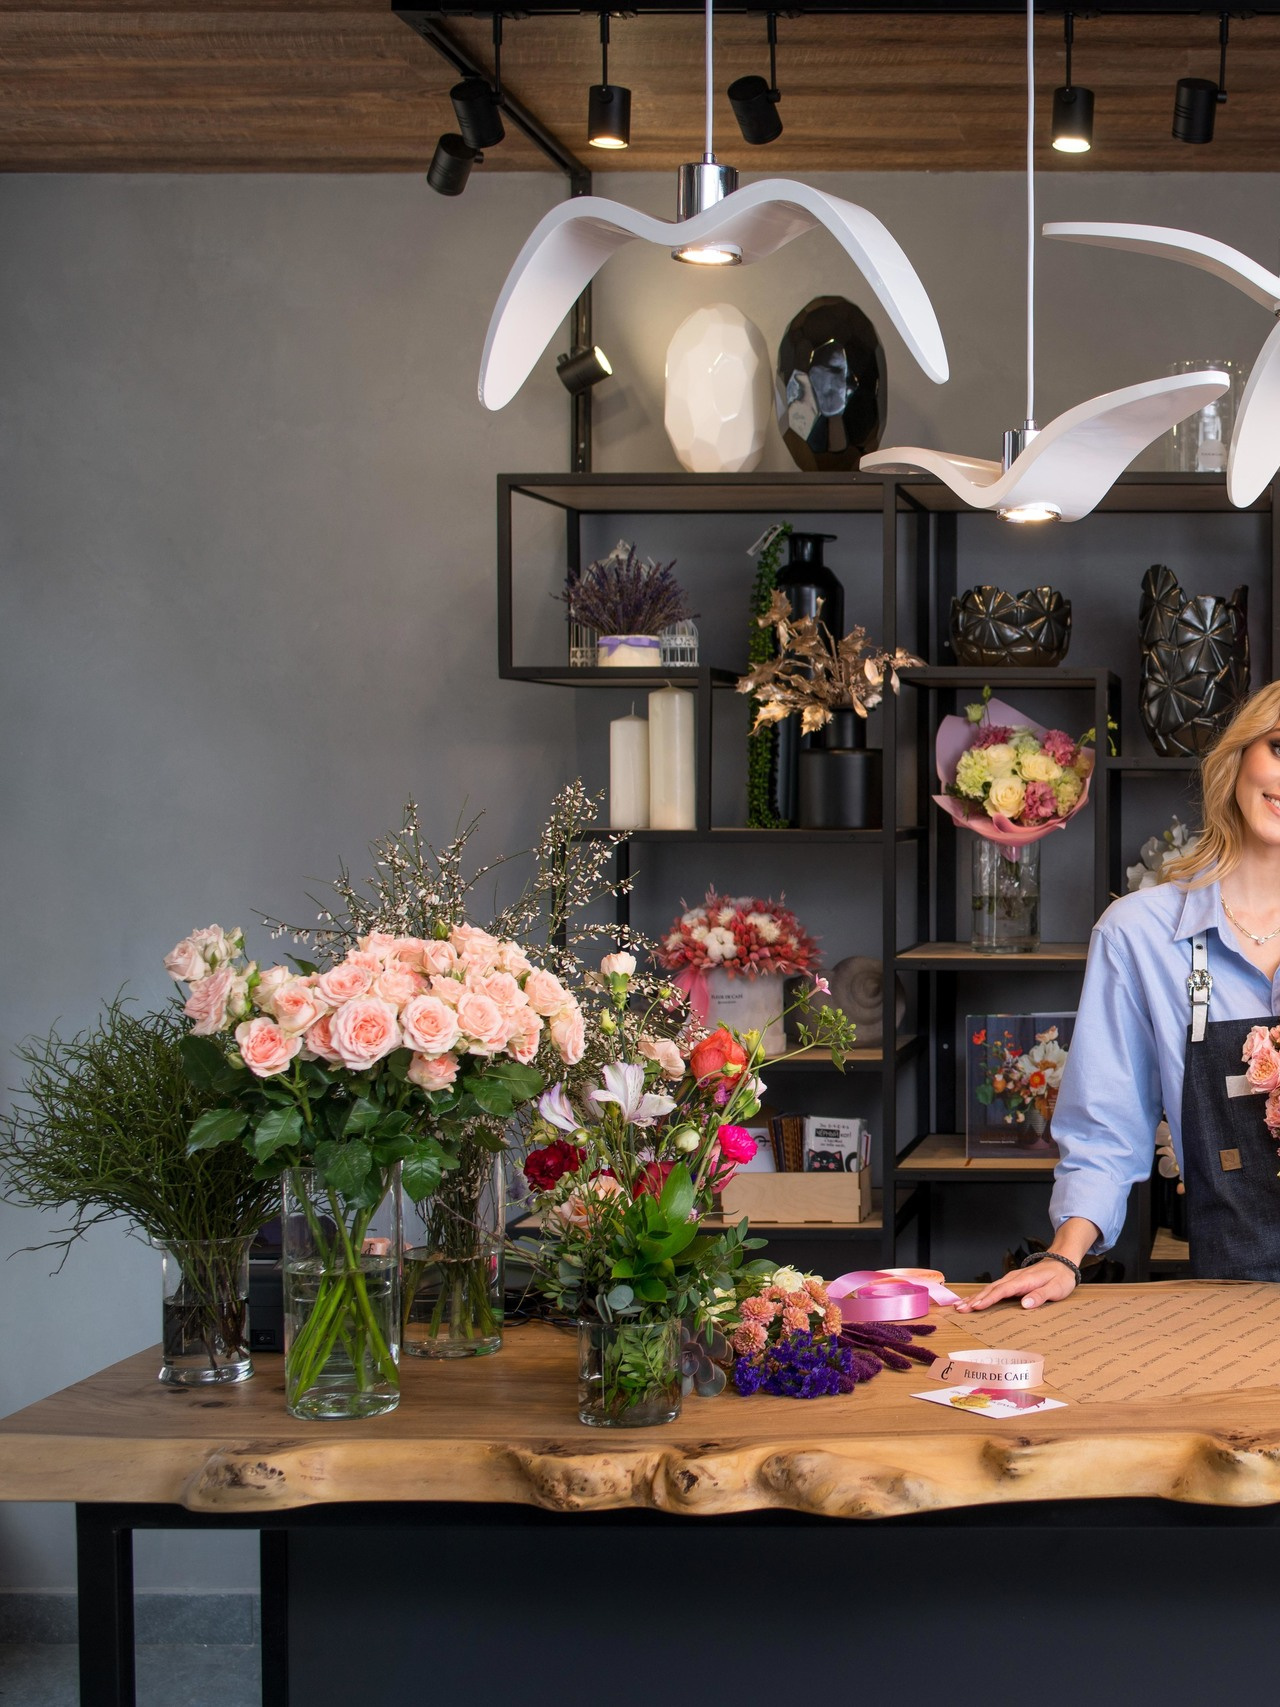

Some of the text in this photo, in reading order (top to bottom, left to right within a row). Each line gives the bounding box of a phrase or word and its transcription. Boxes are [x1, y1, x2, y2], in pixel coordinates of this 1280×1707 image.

[964, 1369, 1029, 1381] FLEUR DE CAFÉ
